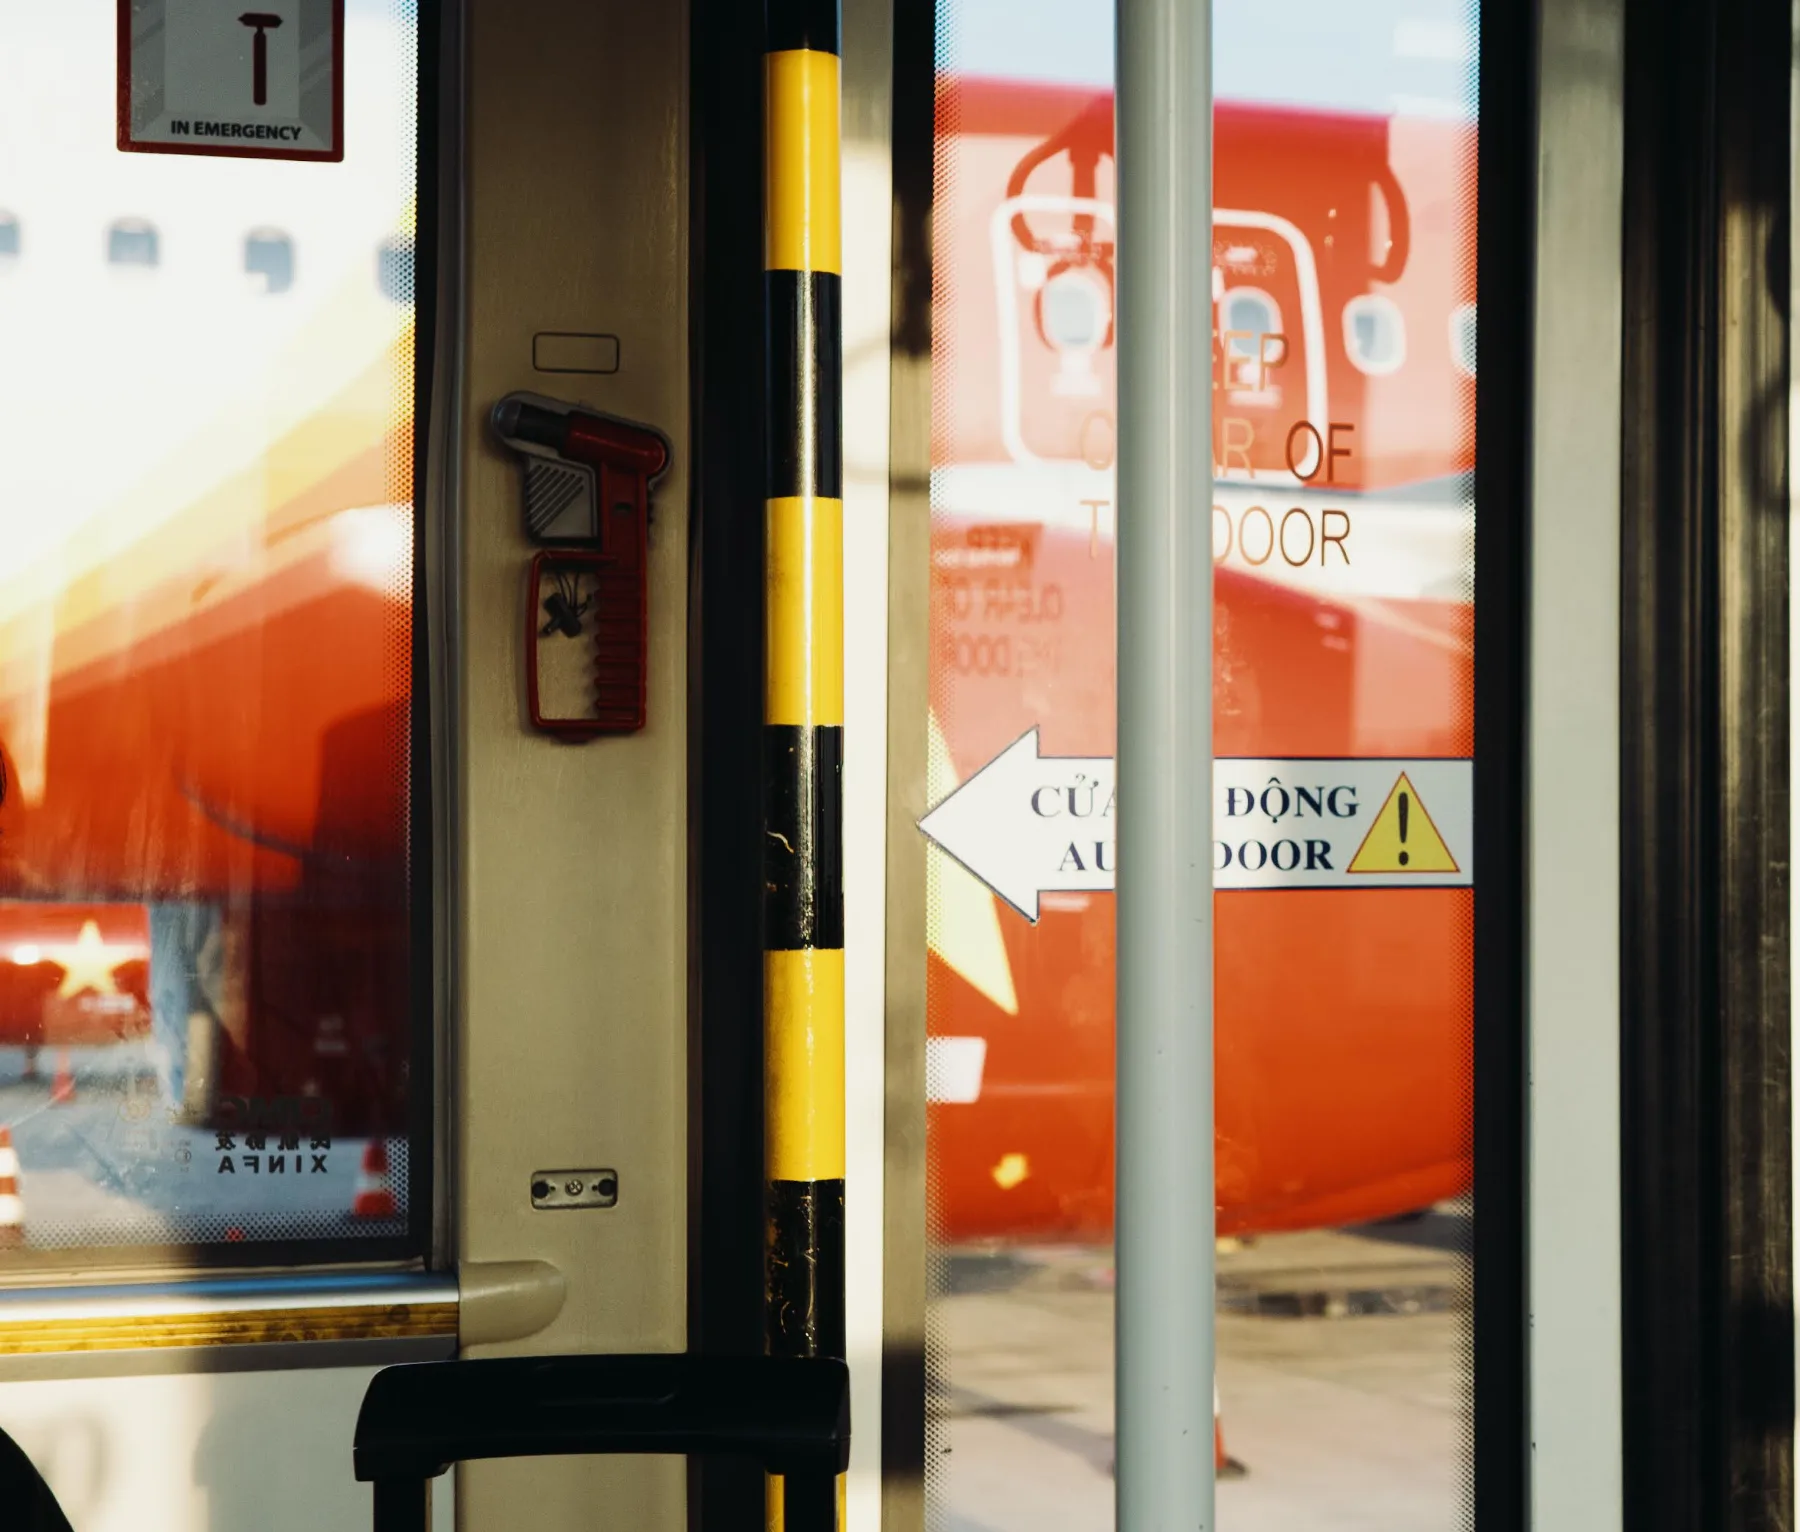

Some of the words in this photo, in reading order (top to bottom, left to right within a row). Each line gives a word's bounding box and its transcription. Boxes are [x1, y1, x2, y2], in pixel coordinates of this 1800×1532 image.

[171, 120, 190, 134] IN
[193, 121, 302, 140] EMERGENCY
[1285, 420, 1355, 482] OF
[1225, 777, 1360, 823] ĐỘNG
[1057, 840, 1117, 872] AU
